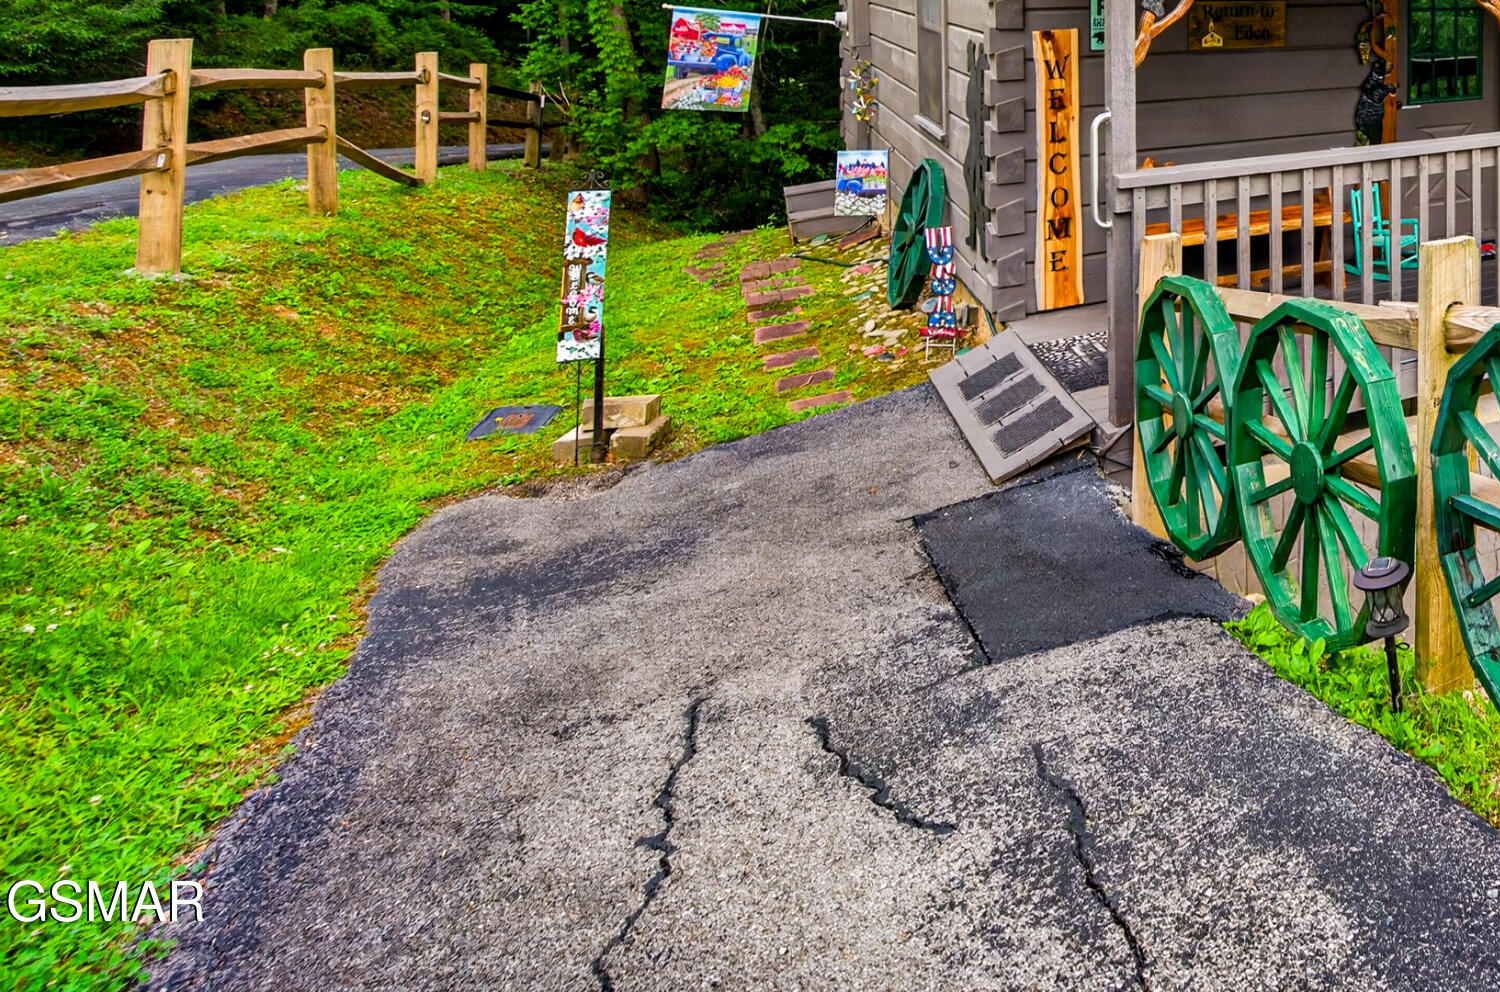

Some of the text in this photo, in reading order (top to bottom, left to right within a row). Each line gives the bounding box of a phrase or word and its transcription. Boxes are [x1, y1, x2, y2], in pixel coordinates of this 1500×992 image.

[1202, 5, 1275, 22] Return to
[1234, 24, 1271, 41] Eden
[1044, 53, 1072, 273] WELCOME
